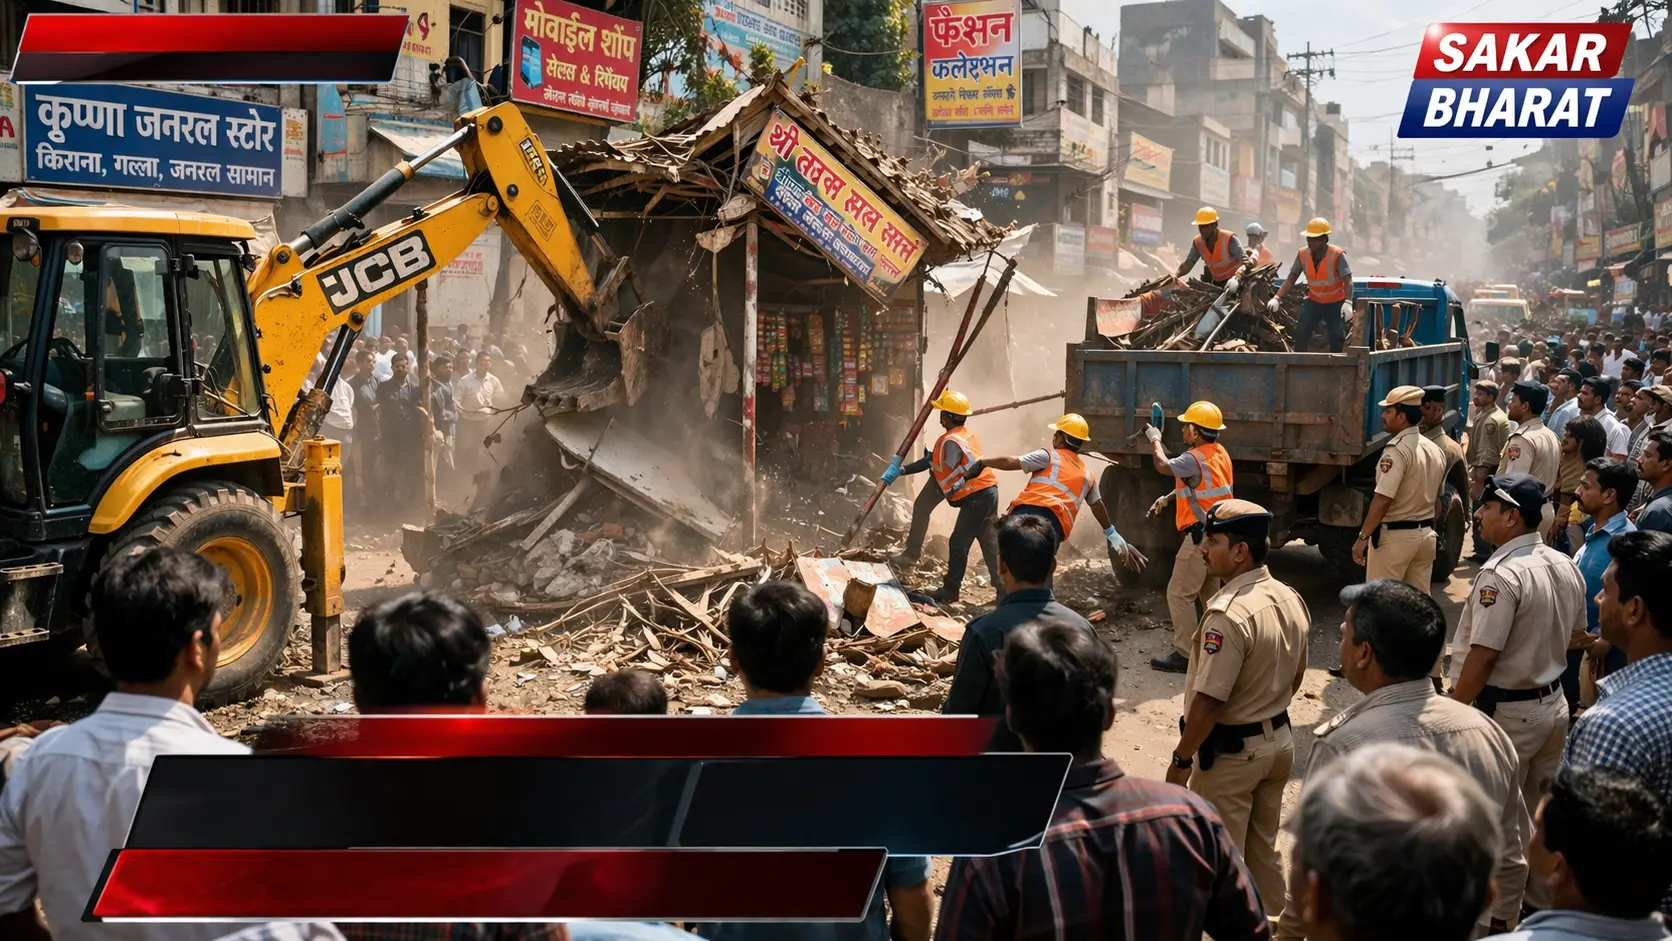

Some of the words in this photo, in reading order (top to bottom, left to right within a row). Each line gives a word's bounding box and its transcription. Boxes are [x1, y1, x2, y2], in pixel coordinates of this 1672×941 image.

[580, 64, 590, 86] &
[133, 105, 220, 147] जनरल
[225, 107, 277, 152] स्टोर
[769, 123, 800, 162] श्री
[35, 141, 107, 178] किराना,
[113, 154, 164, 181] गल्ला,
[169, 159, 222, 183] जनरल
[226, 164, 275, 188] सामान
[321, 235, 431, 308] JCB
